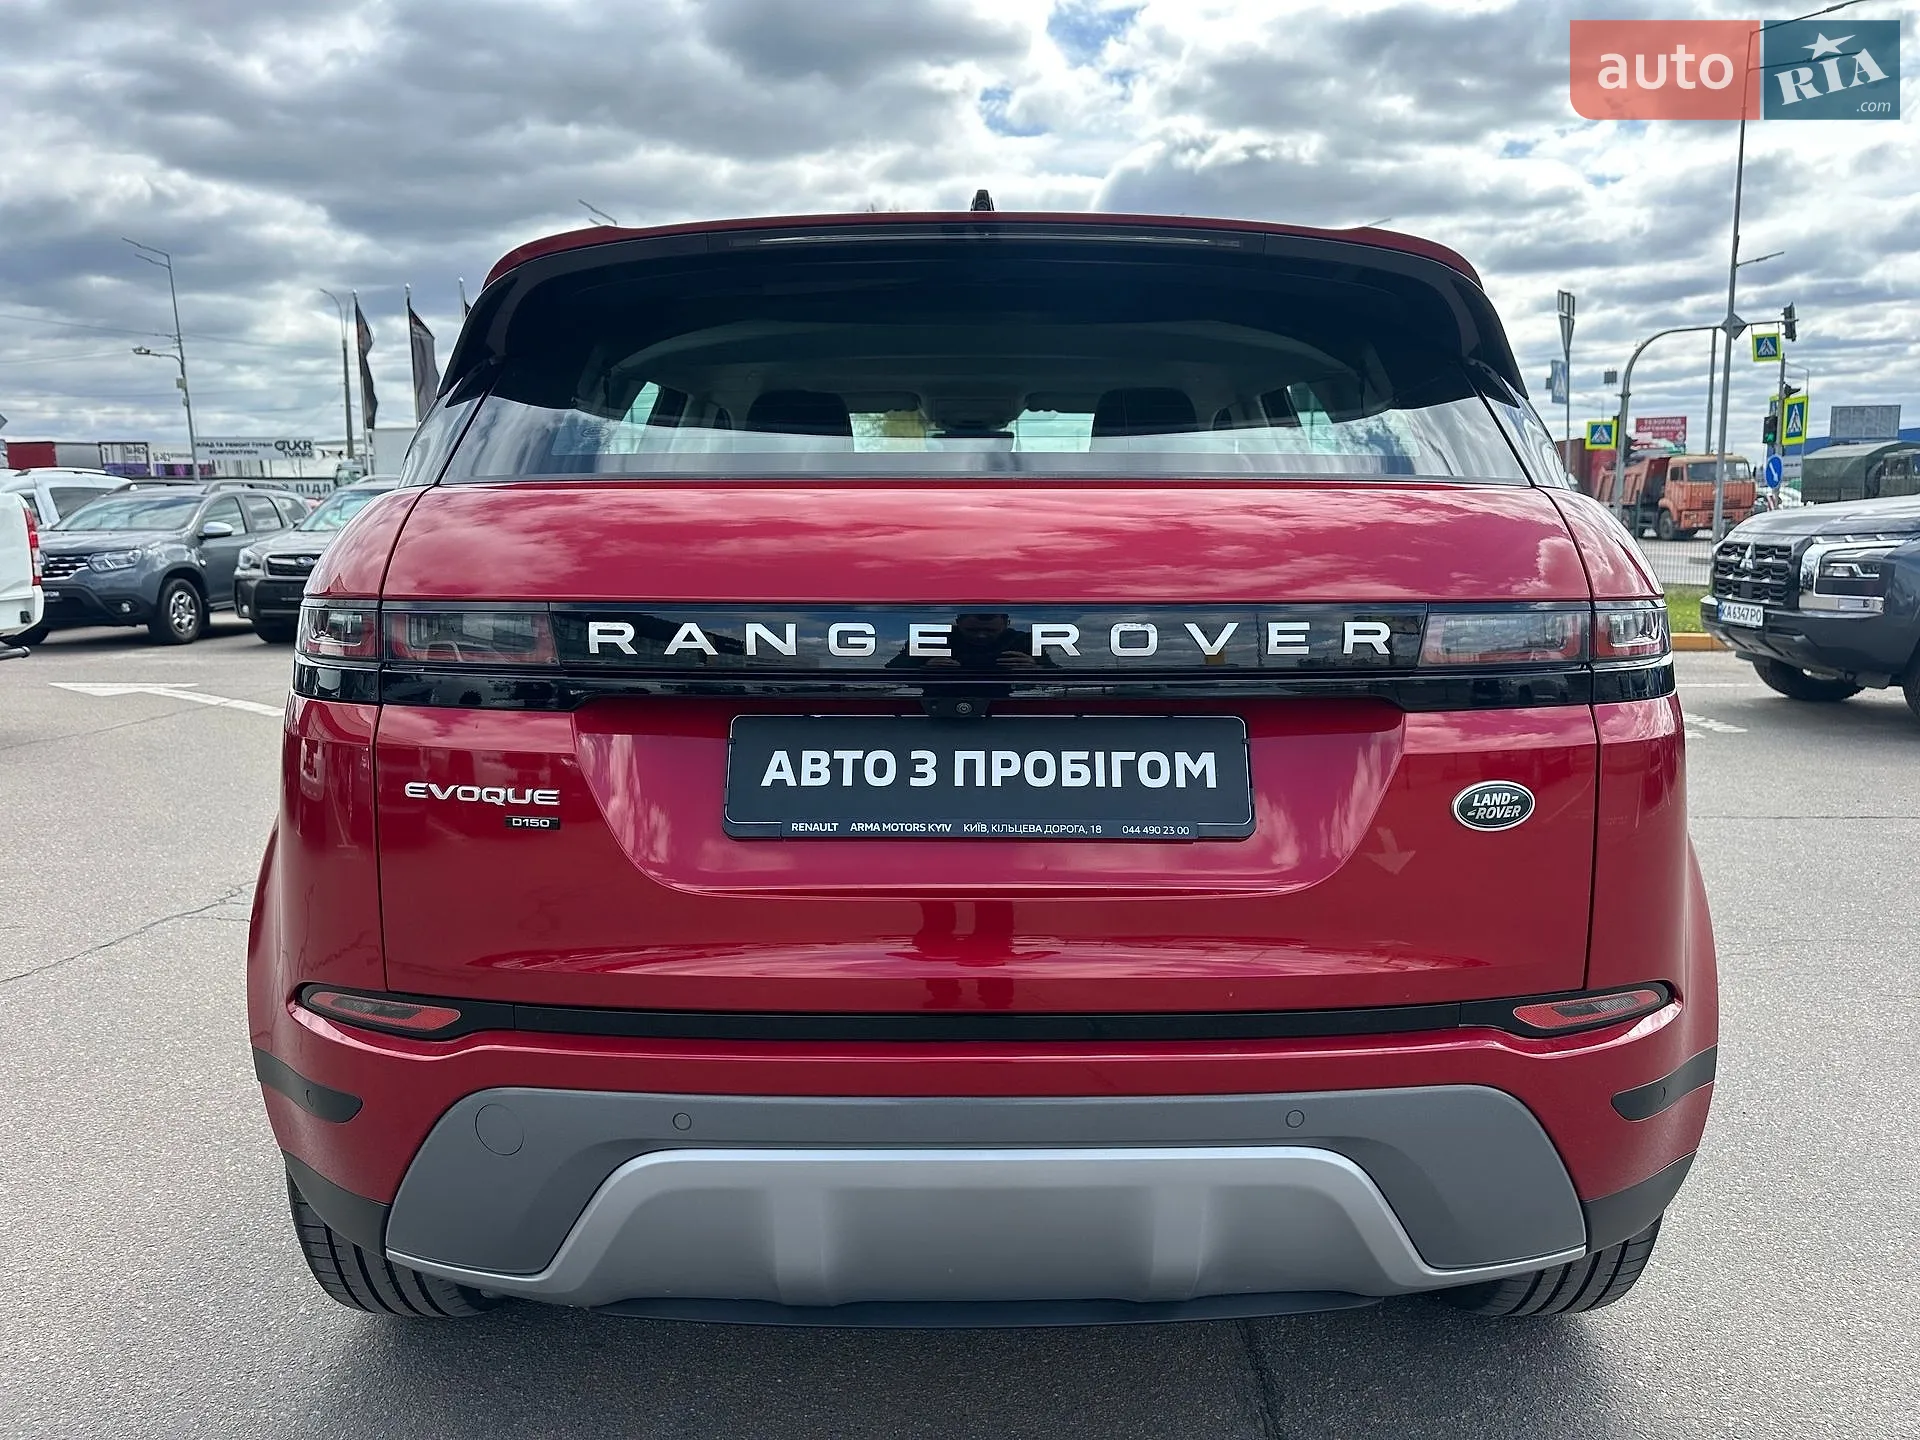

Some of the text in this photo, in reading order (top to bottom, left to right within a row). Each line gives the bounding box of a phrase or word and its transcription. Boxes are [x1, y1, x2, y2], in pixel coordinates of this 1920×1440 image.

[588, 621, 1392, 657] RANGE ROVER
[761, 749, 1218, 789] АВТО З ПРОБІГОМ
[404, 781, 561, 807] EVOQUE
[1472, 792, 1511, 807] LAND
[1474, 804, 1522, 820] ROVER
[511, 817, 550, 828] D150
[791, 821, 1190, 835] RENAULT ARMA MOTORS KYIV КИЇВ, КІЛЬЦЕВА ДОРОГА, 18 044 490 23 00
